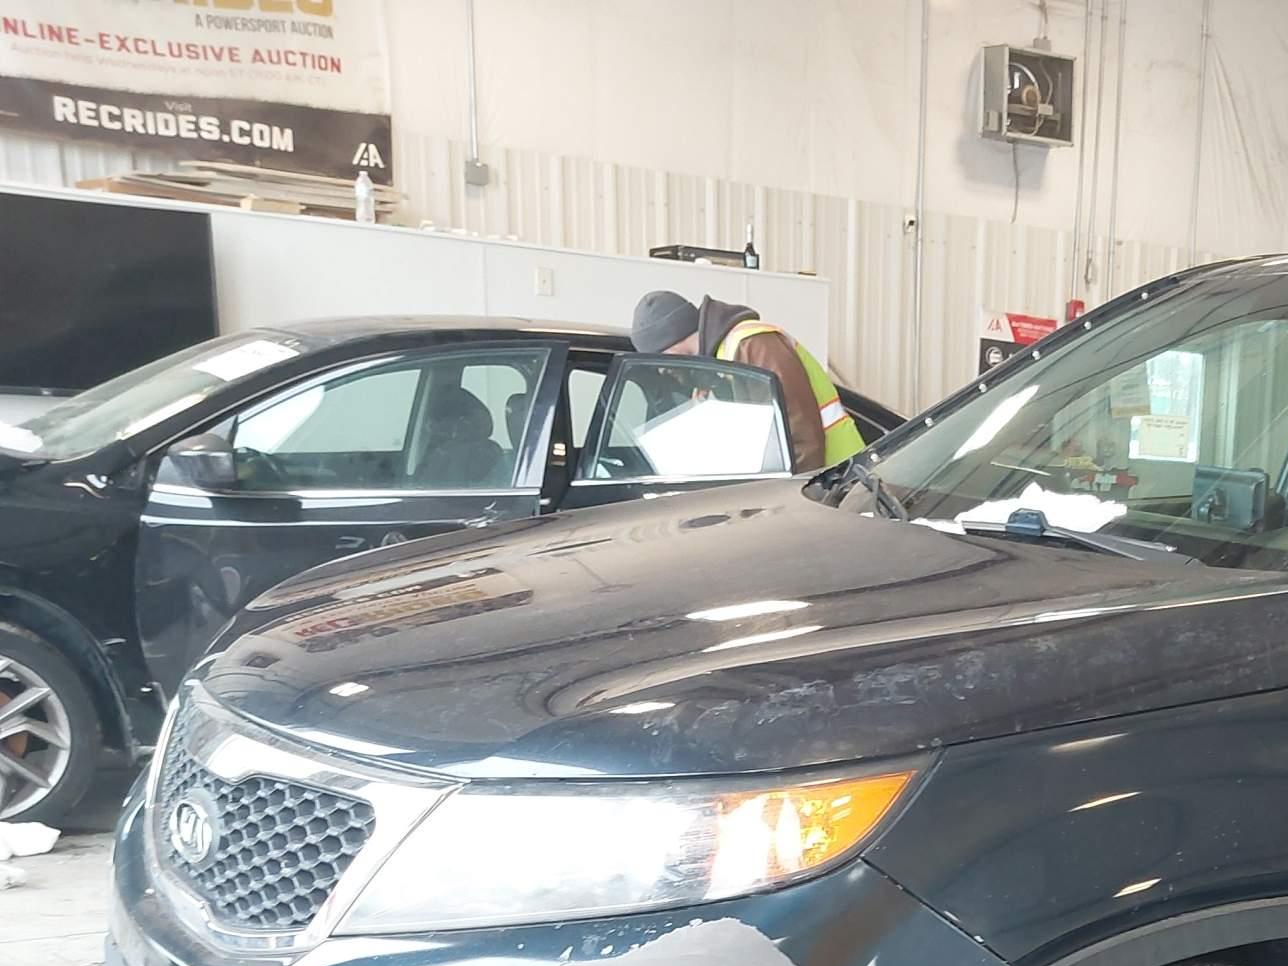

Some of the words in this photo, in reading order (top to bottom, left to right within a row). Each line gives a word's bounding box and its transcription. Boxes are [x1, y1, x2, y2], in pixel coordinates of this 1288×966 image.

[0, 16, 242, 64] NLINE-EXCLUSIVE
[251, 48, 342, 74] AUCTION
[195, 13, 203, 28] A
[206, 14, 287, 34] POWERSPORT
[290, 20, 334, 39] AUCTION
[52, 94, 295, 153] RECRIDES.COM
[165, 101, 193, 113] Visit
